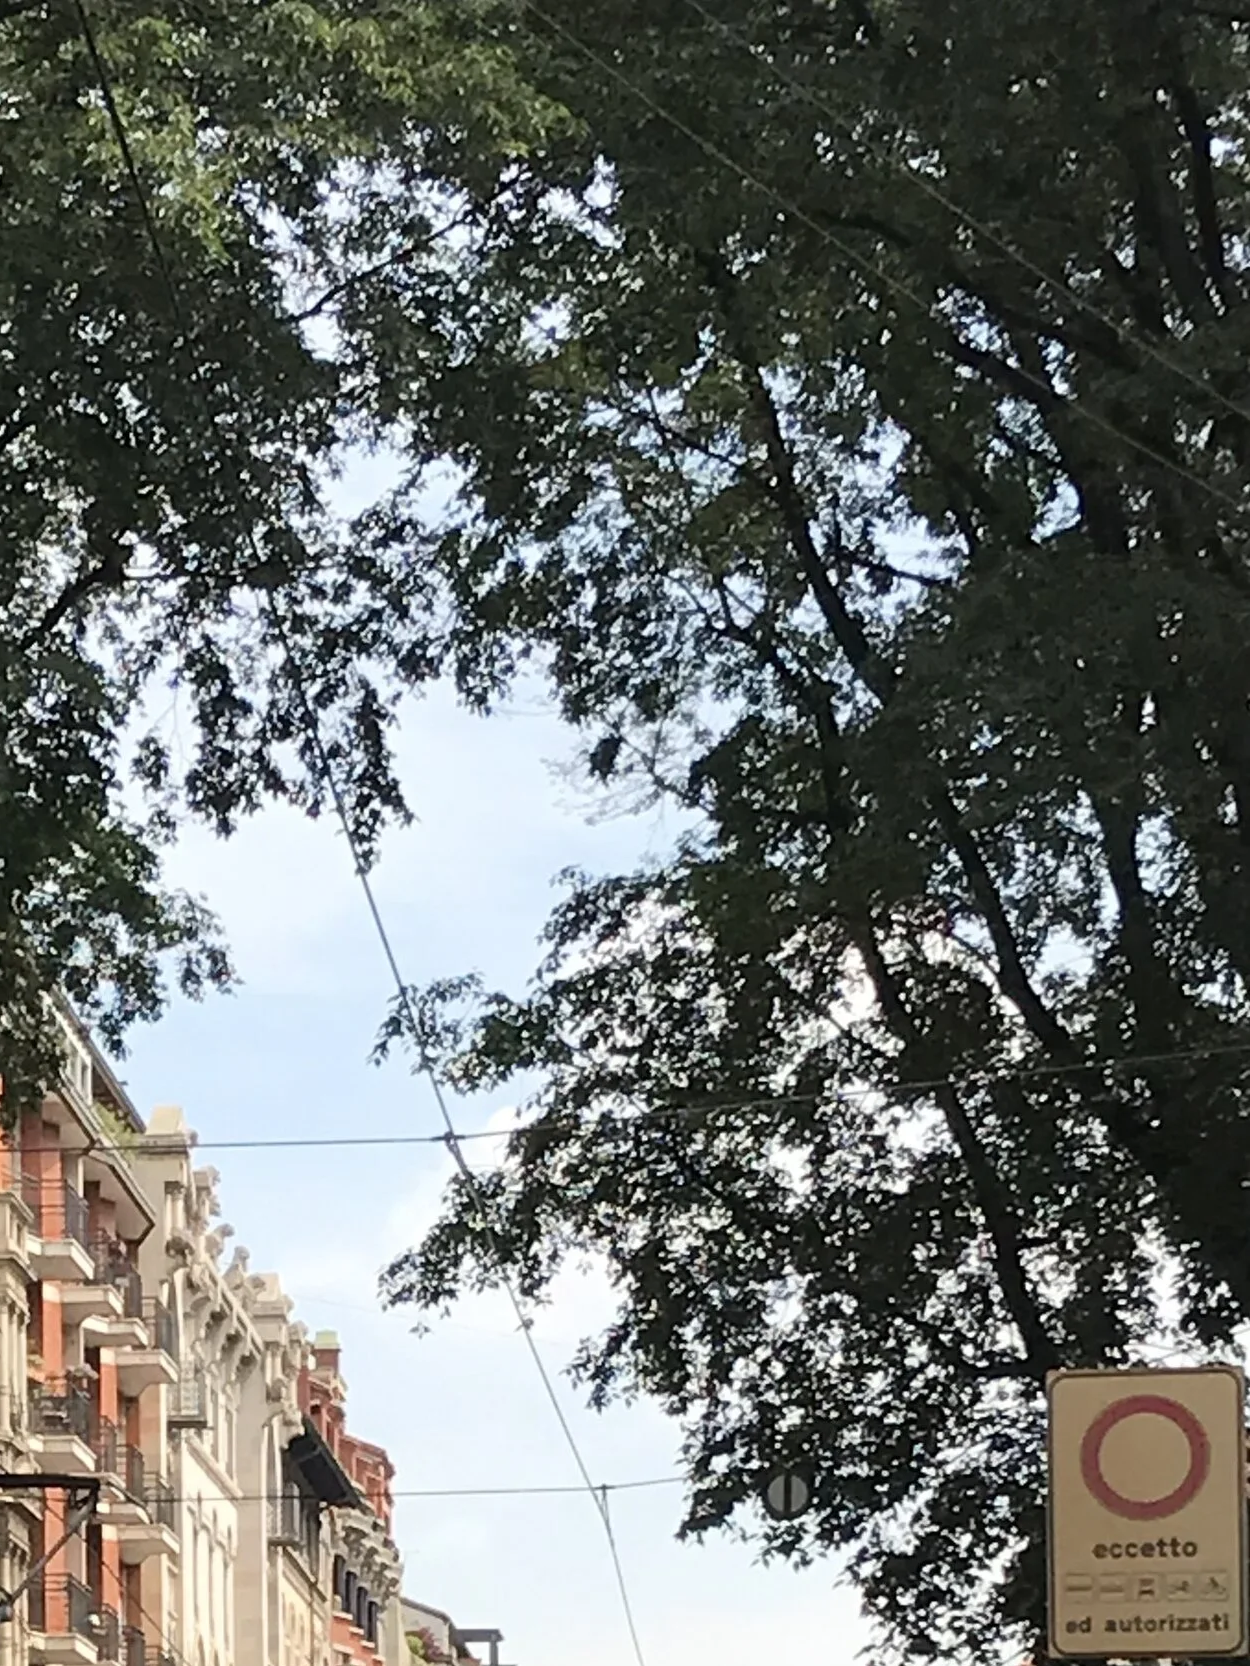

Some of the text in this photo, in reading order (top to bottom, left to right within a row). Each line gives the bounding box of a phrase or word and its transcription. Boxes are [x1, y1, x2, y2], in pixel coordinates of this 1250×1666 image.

[1092, 1537, 1198, 1559] eccetto
[1065, 1613, 1230, 1634] ed autorizzati
